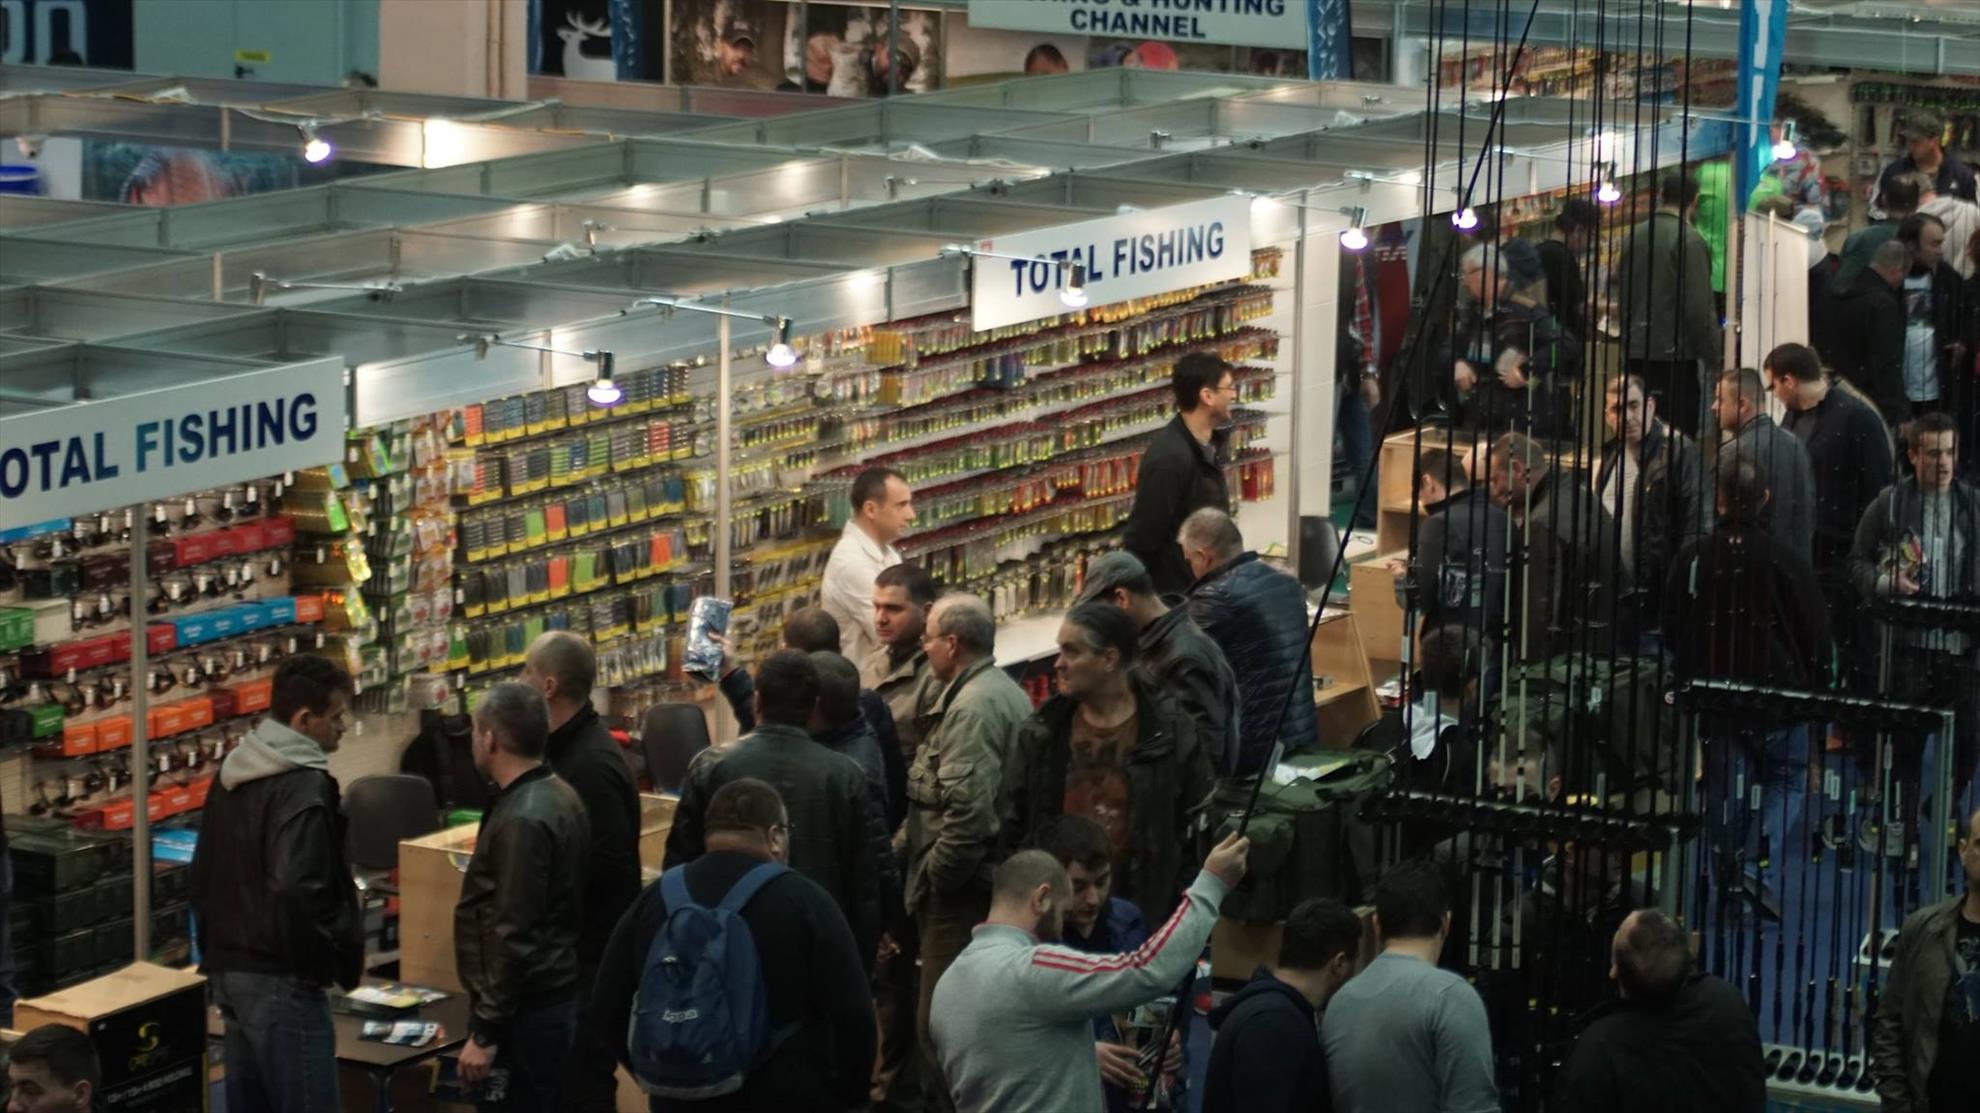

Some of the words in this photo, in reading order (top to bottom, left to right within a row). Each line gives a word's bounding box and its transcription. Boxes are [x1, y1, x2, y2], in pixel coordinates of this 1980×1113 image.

[1070, 9, 1206, 38] CHANNEL
[1113, 221, 1224, 278] FISHING
[136, 393, 317, 472] FISHING
